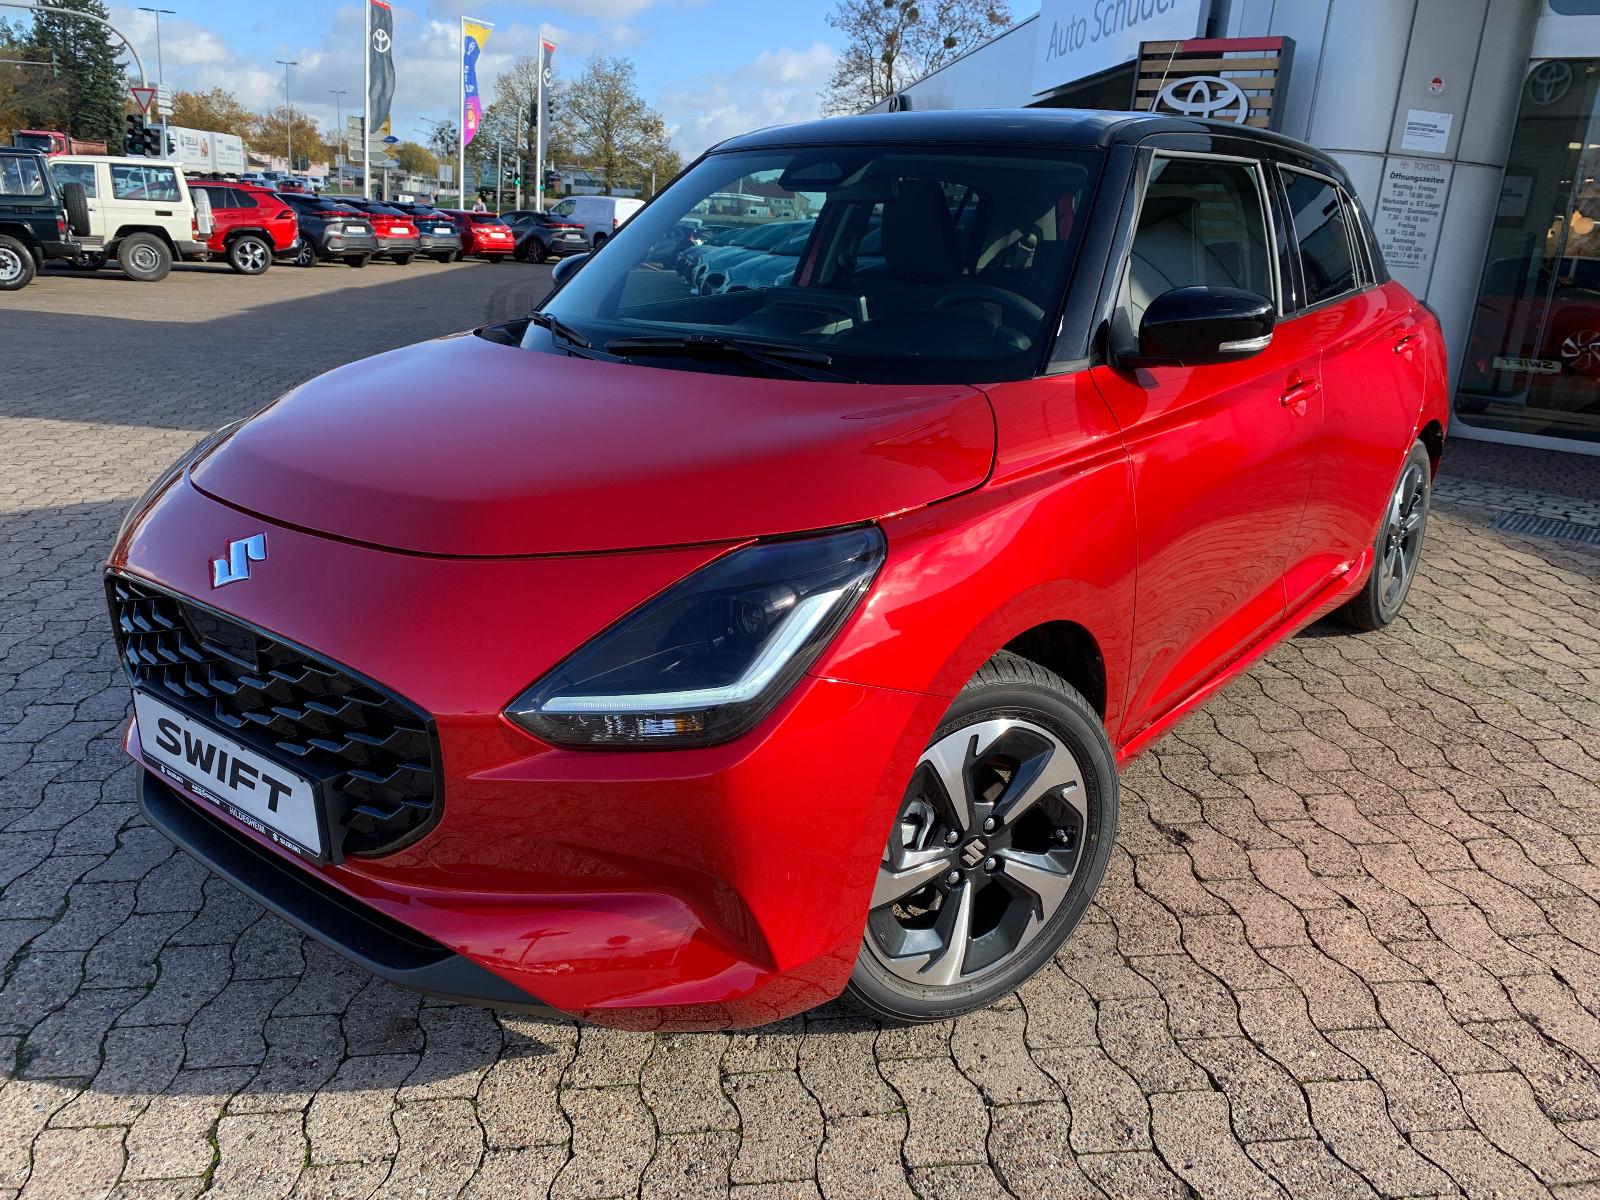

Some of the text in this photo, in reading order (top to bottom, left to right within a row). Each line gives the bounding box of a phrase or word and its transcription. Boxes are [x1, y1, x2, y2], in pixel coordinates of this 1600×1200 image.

[1046, 0, 1175, 62] Auto Schu
[1414, 162, 1440, 171] TOYOTA
[1390, 171, 1445, 184] Öffnungszeiten
[1392, 183, 1414, 191] Montag
[1418, 185, 1438, 193] Freitag
[1407, 208, 1439, 217] Donnerstag
[1398, 222, 1417, 230] Freitag
[1392, 237, 1416, 245] Samstag
[155, 717, 292, 813] SWIFT
[229, 807, 266, 835] HILDESHEIM
